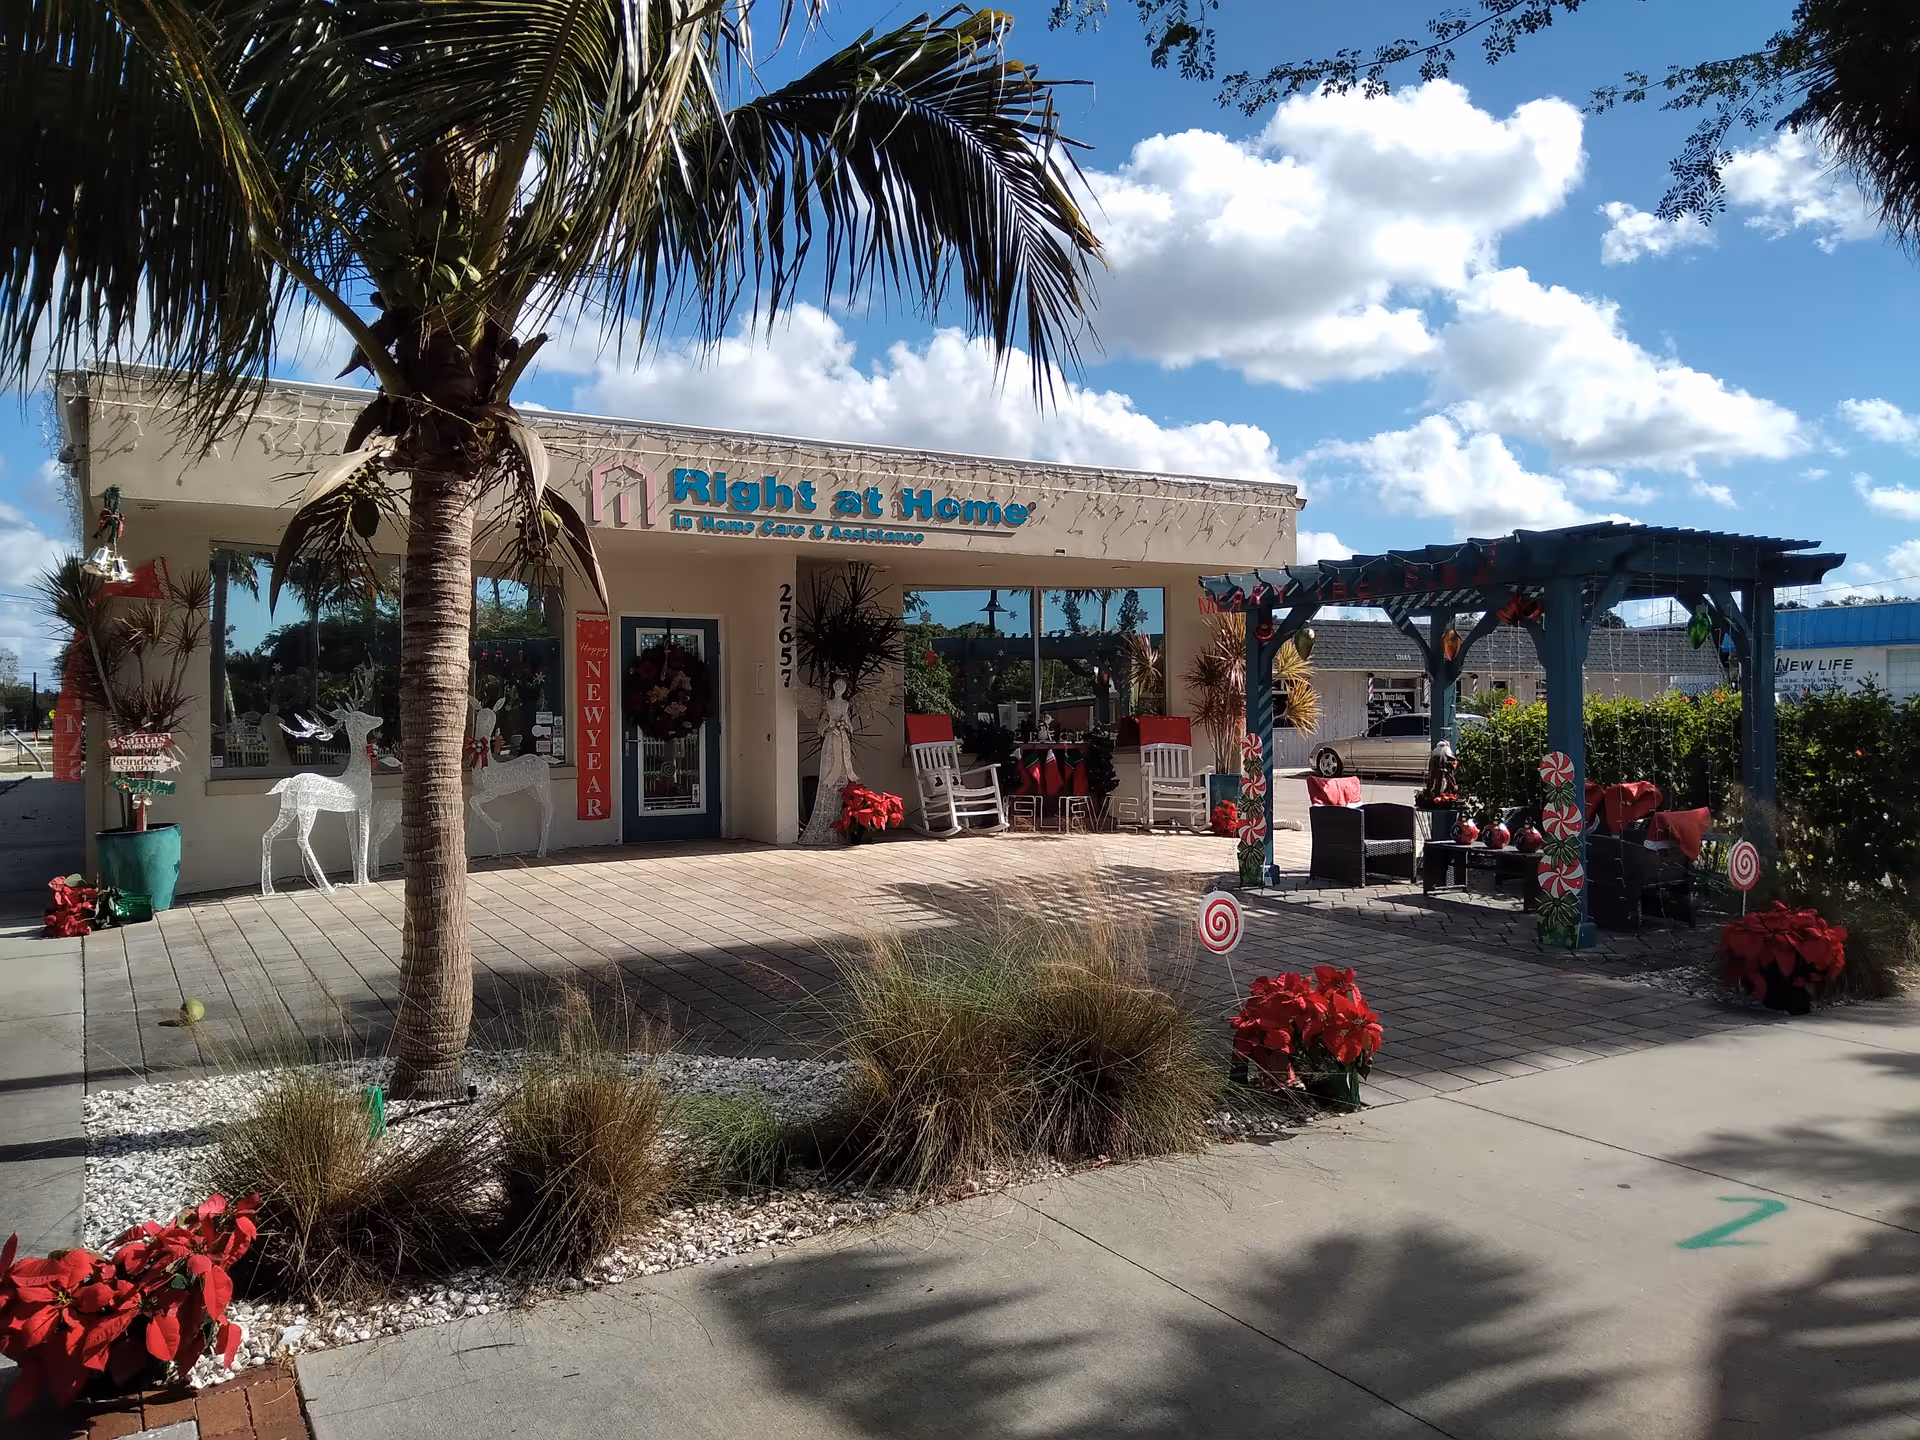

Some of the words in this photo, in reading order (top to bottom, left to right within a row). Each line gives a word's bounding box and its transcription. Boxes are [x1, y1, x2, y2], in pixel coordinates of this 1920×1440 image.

[673, 467, 818, 512] Right
[833, 486, 884, 515] at
[674, 512, 694, 528] In
[702, 515, 756, 532] Home
[763, 520, 806, 536] Care
[812, 523, 825, 537] &
[831, 524, 925, 544] Assistance
[778, 583, 794, 688] 27657
[579, 642, 609, 657] Happy
[1776, 657, 1813, 671] NEW
[1818, 659, 1853, 670] LIFE
[113, 757, 160, 767] Reindeer
